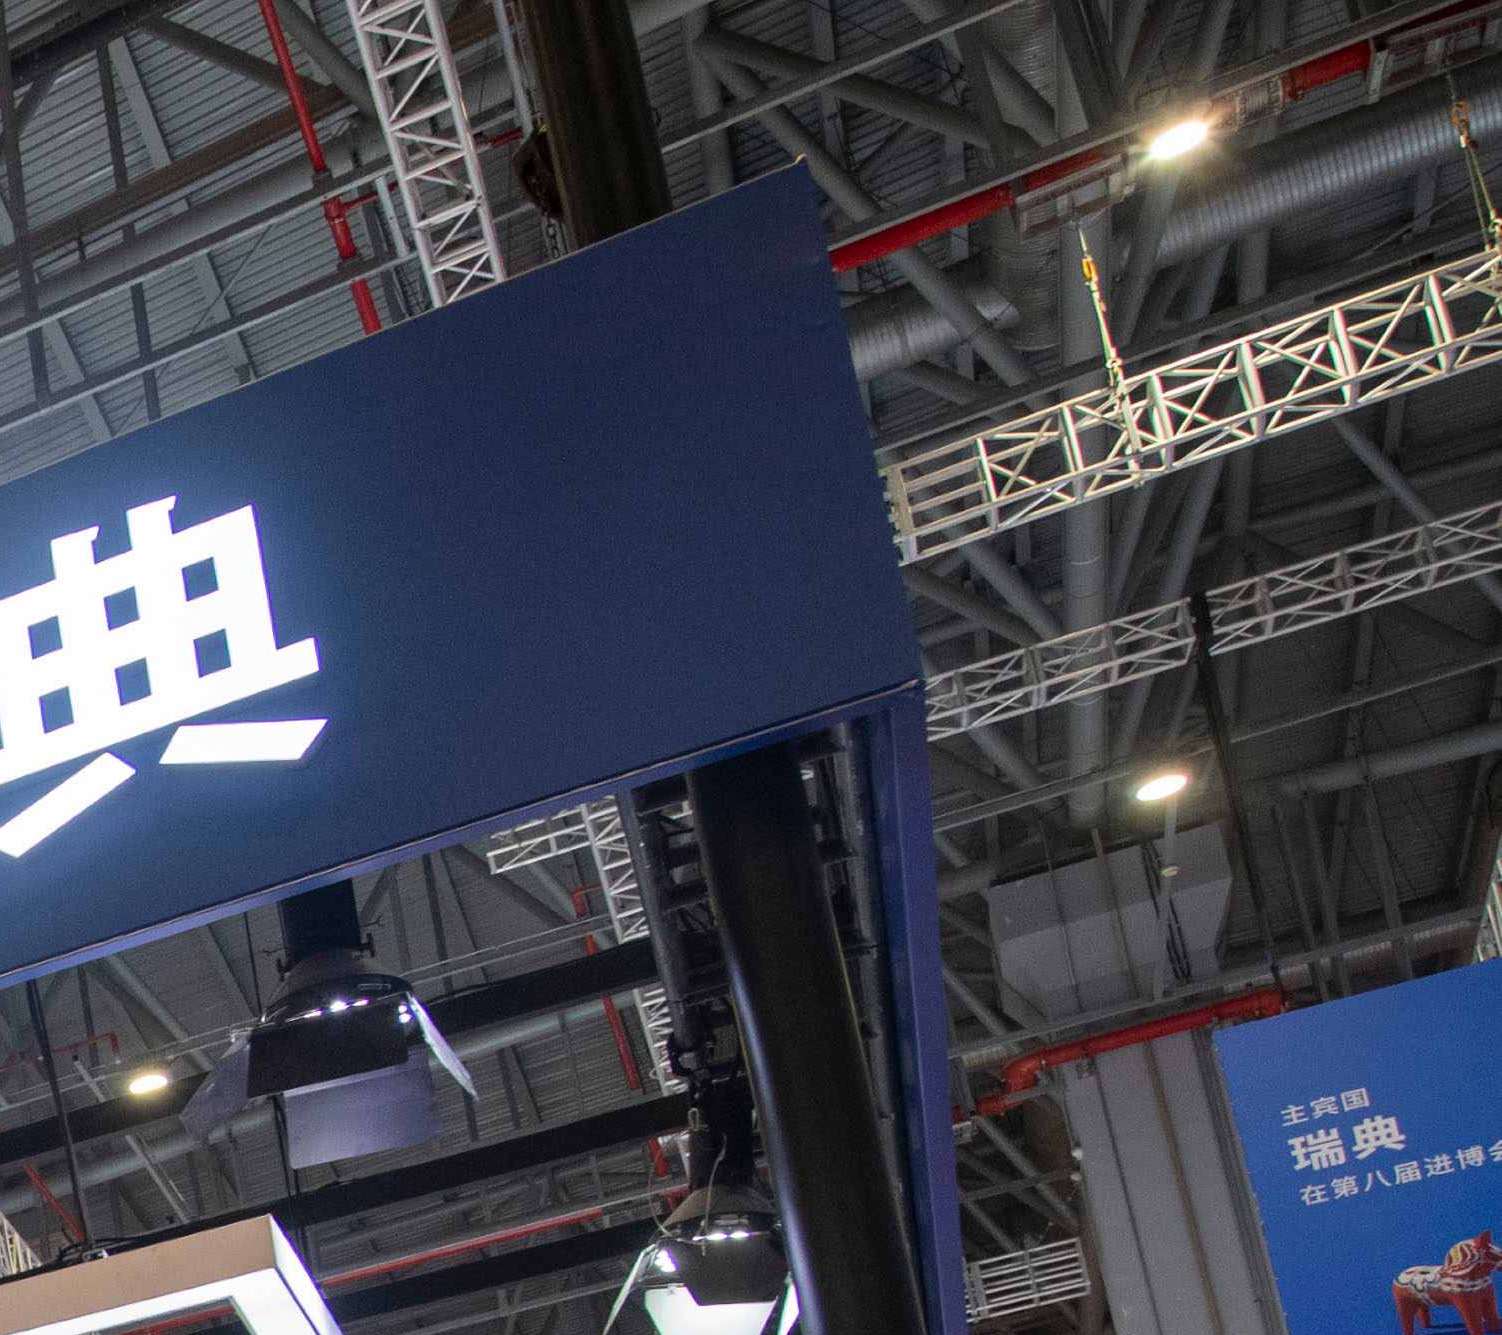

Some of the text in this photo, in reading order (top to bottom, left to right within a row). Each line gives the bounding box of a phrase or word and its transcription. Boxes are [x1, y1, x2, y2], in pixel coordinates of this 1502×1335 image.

[1280, 1087, 1370, 1127] 主宾国
[1287, 1114, 1406, 1171] 瑞典
